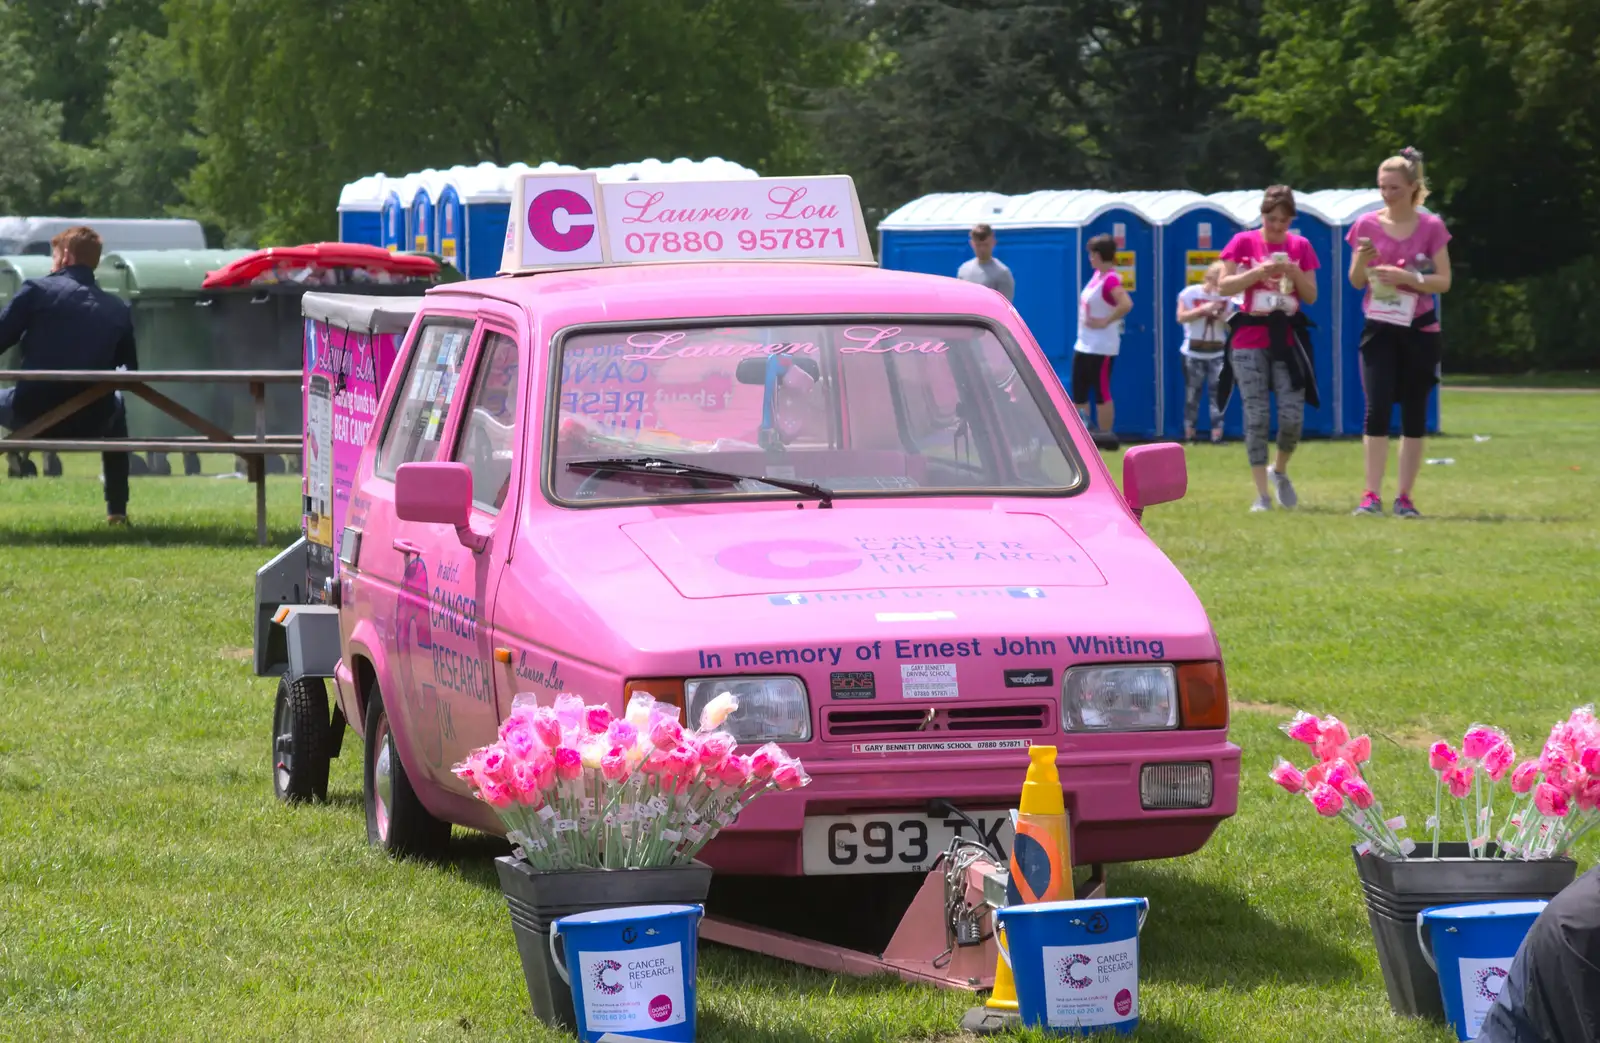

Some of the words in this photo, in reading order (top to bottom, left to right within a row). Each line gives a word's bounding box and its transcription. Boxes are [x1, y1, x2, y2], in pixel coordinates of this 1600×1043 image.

[622, 191, 752, 223] Lauren
[766, 186, 839, 220] Lou
[528, 189, 595, 252] C
[625, 231, 723, 254] 07880
[737, 227, 845, 250] 957871
[623, 332, 818, 360] Lauren
[840, 326, 949, 353] Lou
[353, 387, 369, 414] funds
[335, 414, 349, 443] BEAT
[860, 541, 1024, 550] CANCER
[870, 552, 1077, 563] RESEARCH
[880, 563, 931, 574] UK
[431, 586, 477, 641] CANCER
[699, 650, 722, 669] In
[734, 646, 842, 668] memory
[856, 641, 882, 661] of
[895, 638, 981, 659] Ernest
[993, 635, 1056, 657] John
[1066, 633, 1165, 659] Whiting
[432, 643, 490, 705] RESEARCH
[516, 650, 543, 685] Lauren
[544, 660, 565, 691] Lou
[832, 679, 872, 688] SIGNS
[437, 699, 457, 740] UK
[917, 742, 945, 750] DRIVING
[828, 820, 928, 865] G93
[628, 958, 665, 970] CANCER
[1096, 952, 1128, 964] CANCER
[629, 966, 675, 980] RESEARCH
[1097, 960, 1133, 974] RESEARCH
[629, 981, 643, 990] UK
[1098, 975, 1110, 984] UK
[651, 1004, 670, 1013] DONATE
[652, 1011, 668, 1019] TODAY
